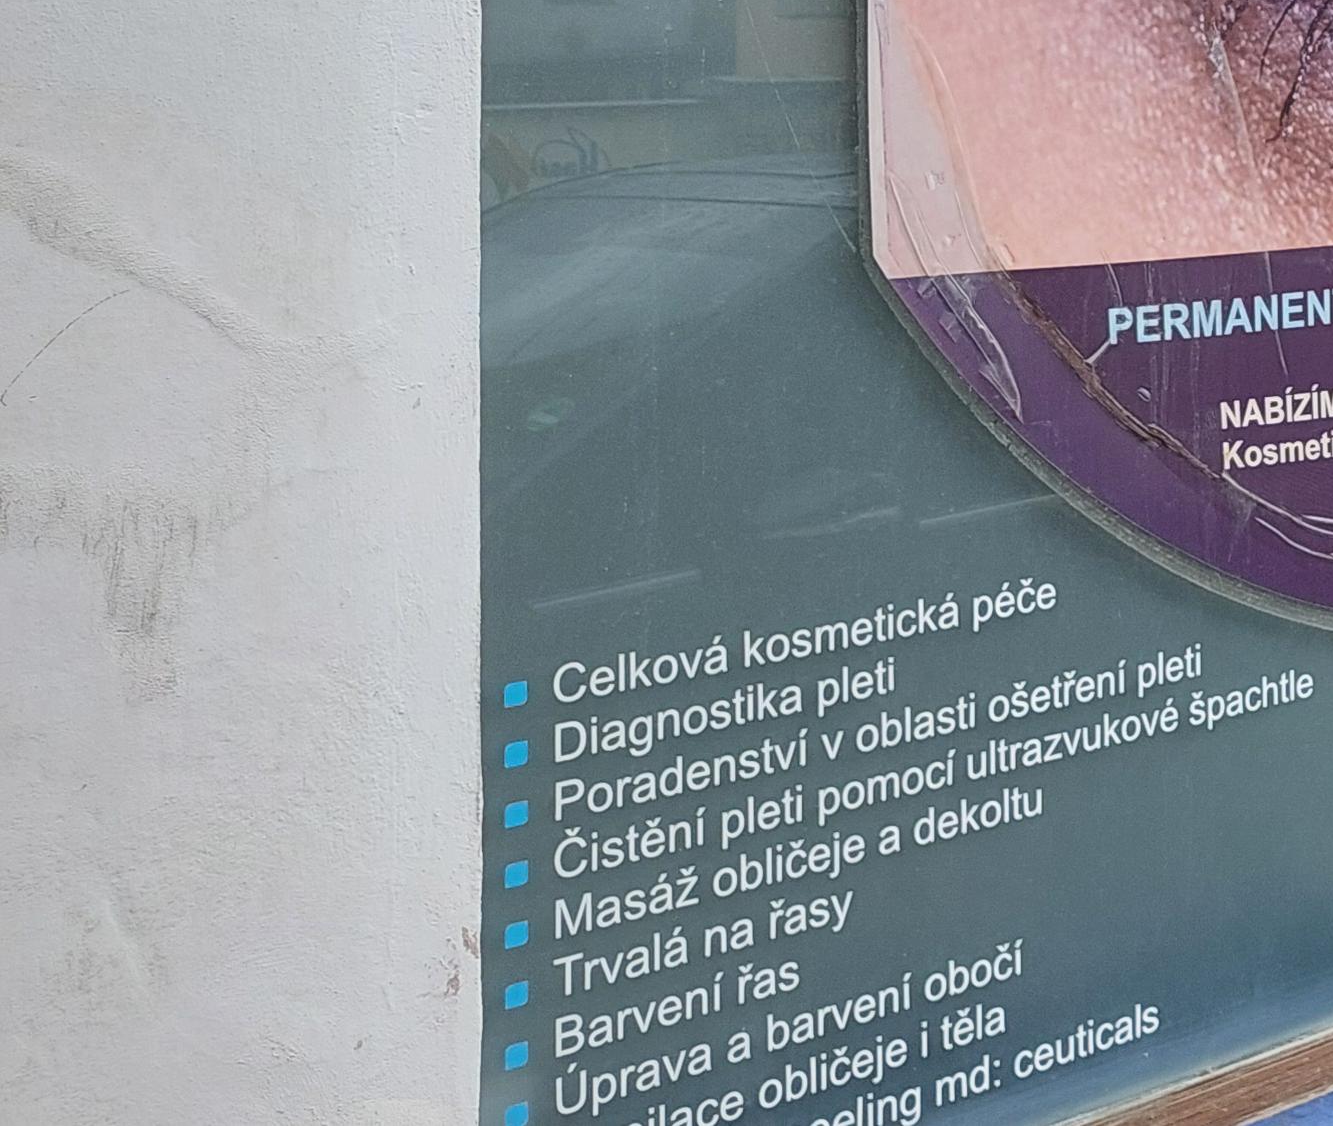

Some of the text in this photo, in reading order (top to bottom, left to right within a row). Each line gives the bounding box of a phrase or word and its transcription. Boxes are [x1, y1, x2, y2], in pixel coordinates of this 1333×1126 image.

[553, 578, 1057, 705] Celková kosmetická péče
[554, 657, 896, 766] Diagnostika pleti
[554, 643, 1203, 821] Poradenství v oblasti ošetření pleti
[553, 670, 1314, 881] Čistění pleti pomocí ultrazvukové špachtle
[553, 786, 1045, 942] Masáž obličeje a dekoltu
[554, 888, 854, 1001] Trvalá na řasy
[554, 956, 801, 1059] Barvení řas
[554, 939, 1024, 1120] Úprava a barvení obočí
[625, 1005, 1007, 1126] ilace obličeje i těla
[934, 1057, 1002, 1106] md:
[1013, 1003, 1161, 1080] ceuticals
